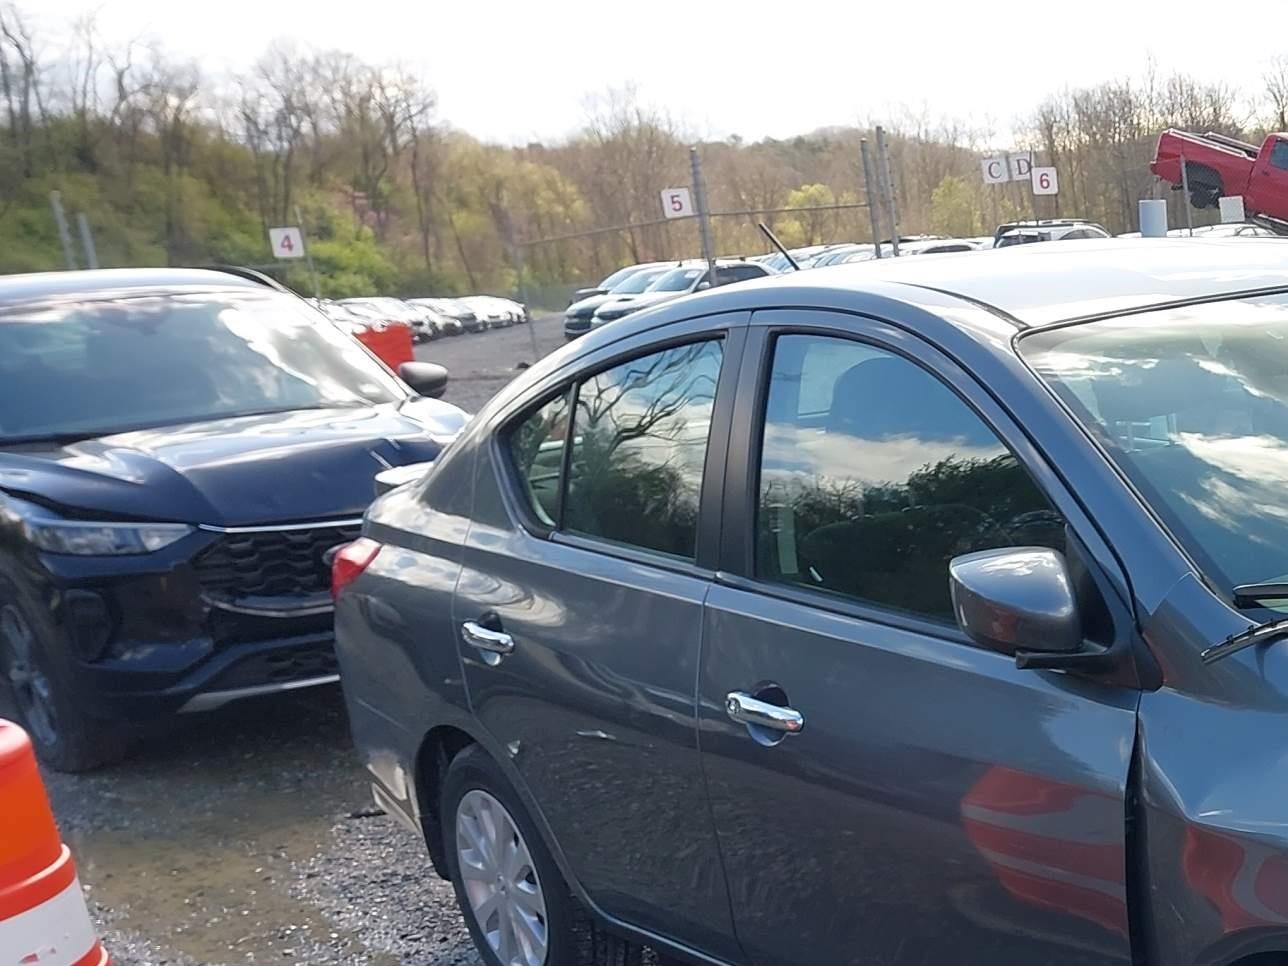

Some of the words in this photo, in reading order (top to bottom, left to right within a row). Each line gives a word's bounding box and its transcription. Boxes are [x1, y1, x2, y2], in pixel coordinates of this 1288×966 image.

[987, 160, 1002, 179] C
[1016, 158, 1031, 176] D
[1039, 172, 1051, 190] 6
[670, 194, 683, 212] 5
[280, 233, 294, 252] 4
